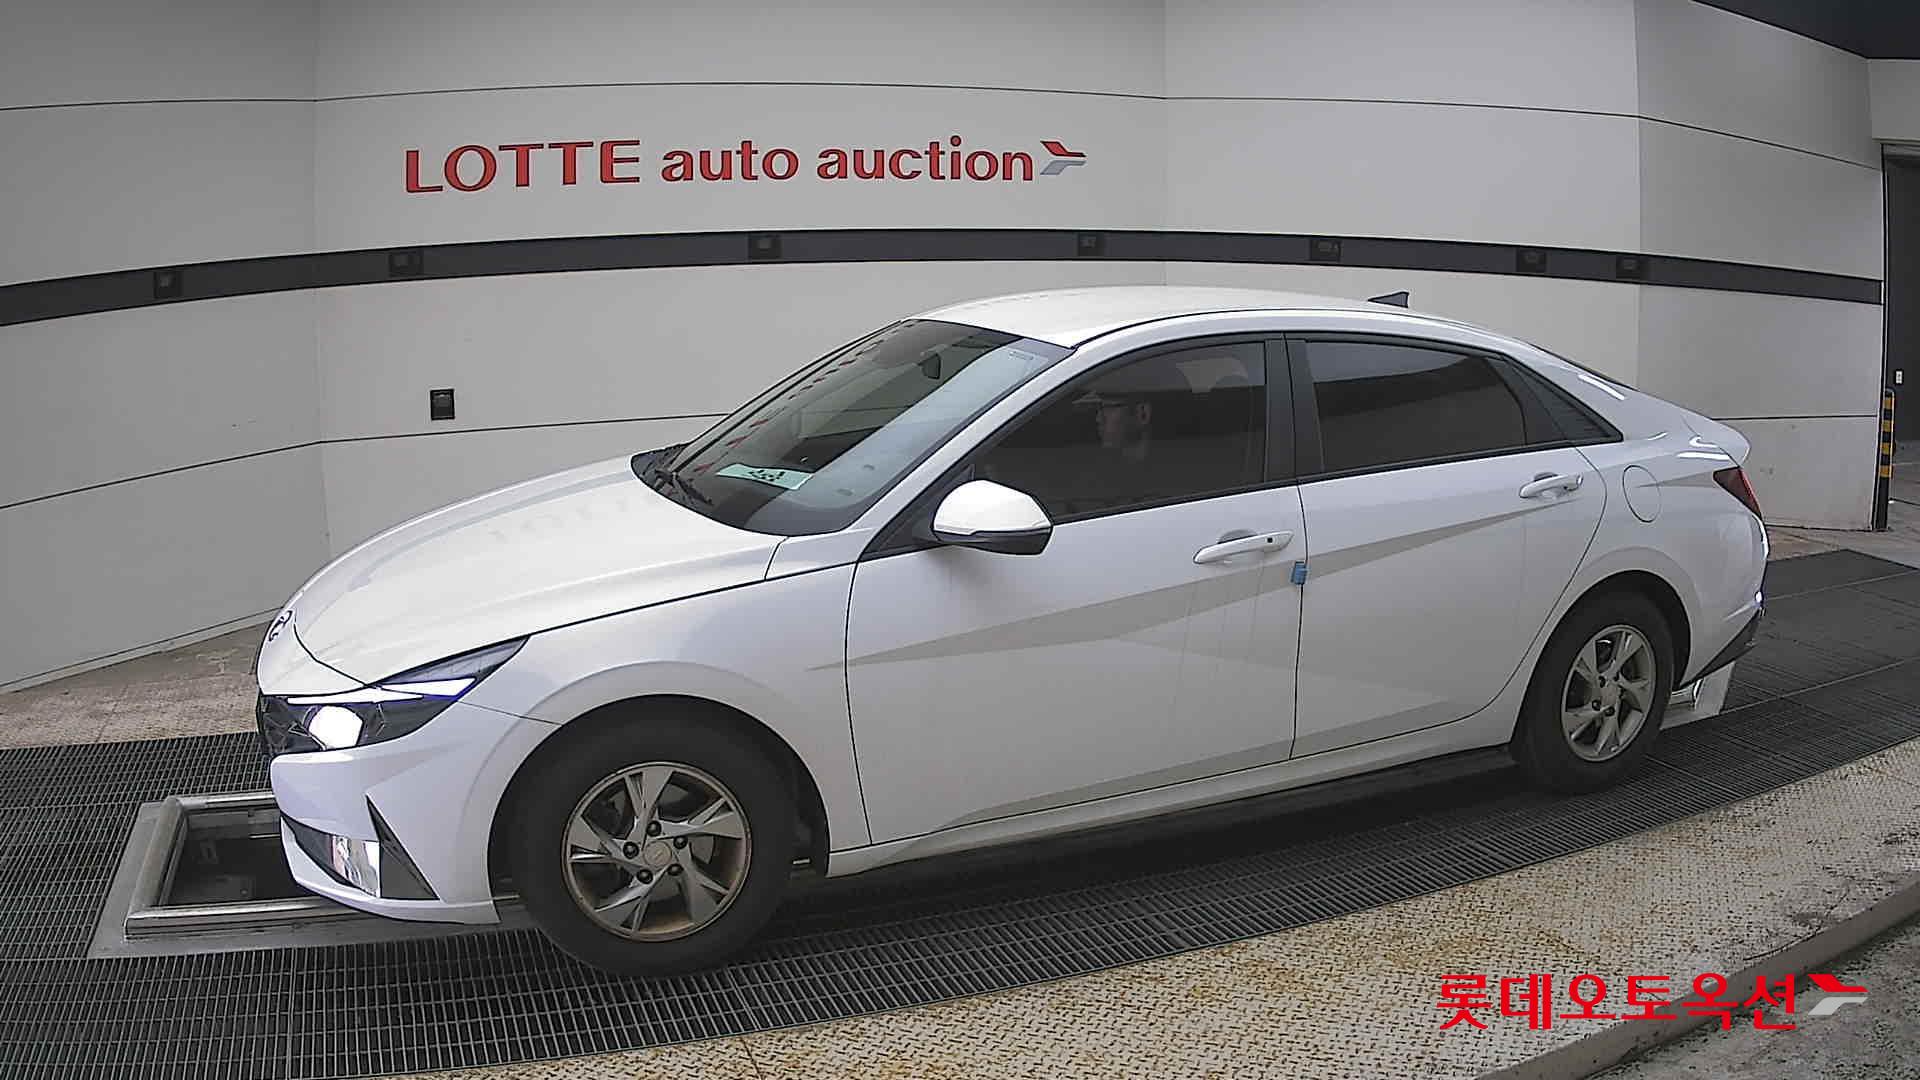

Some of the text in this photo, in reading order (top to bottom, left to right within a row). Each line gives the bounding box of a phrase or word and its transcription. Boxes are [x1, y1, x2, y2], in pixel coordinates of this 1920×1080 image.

[406, 136, 1034, 193] LOTTE auto auction
